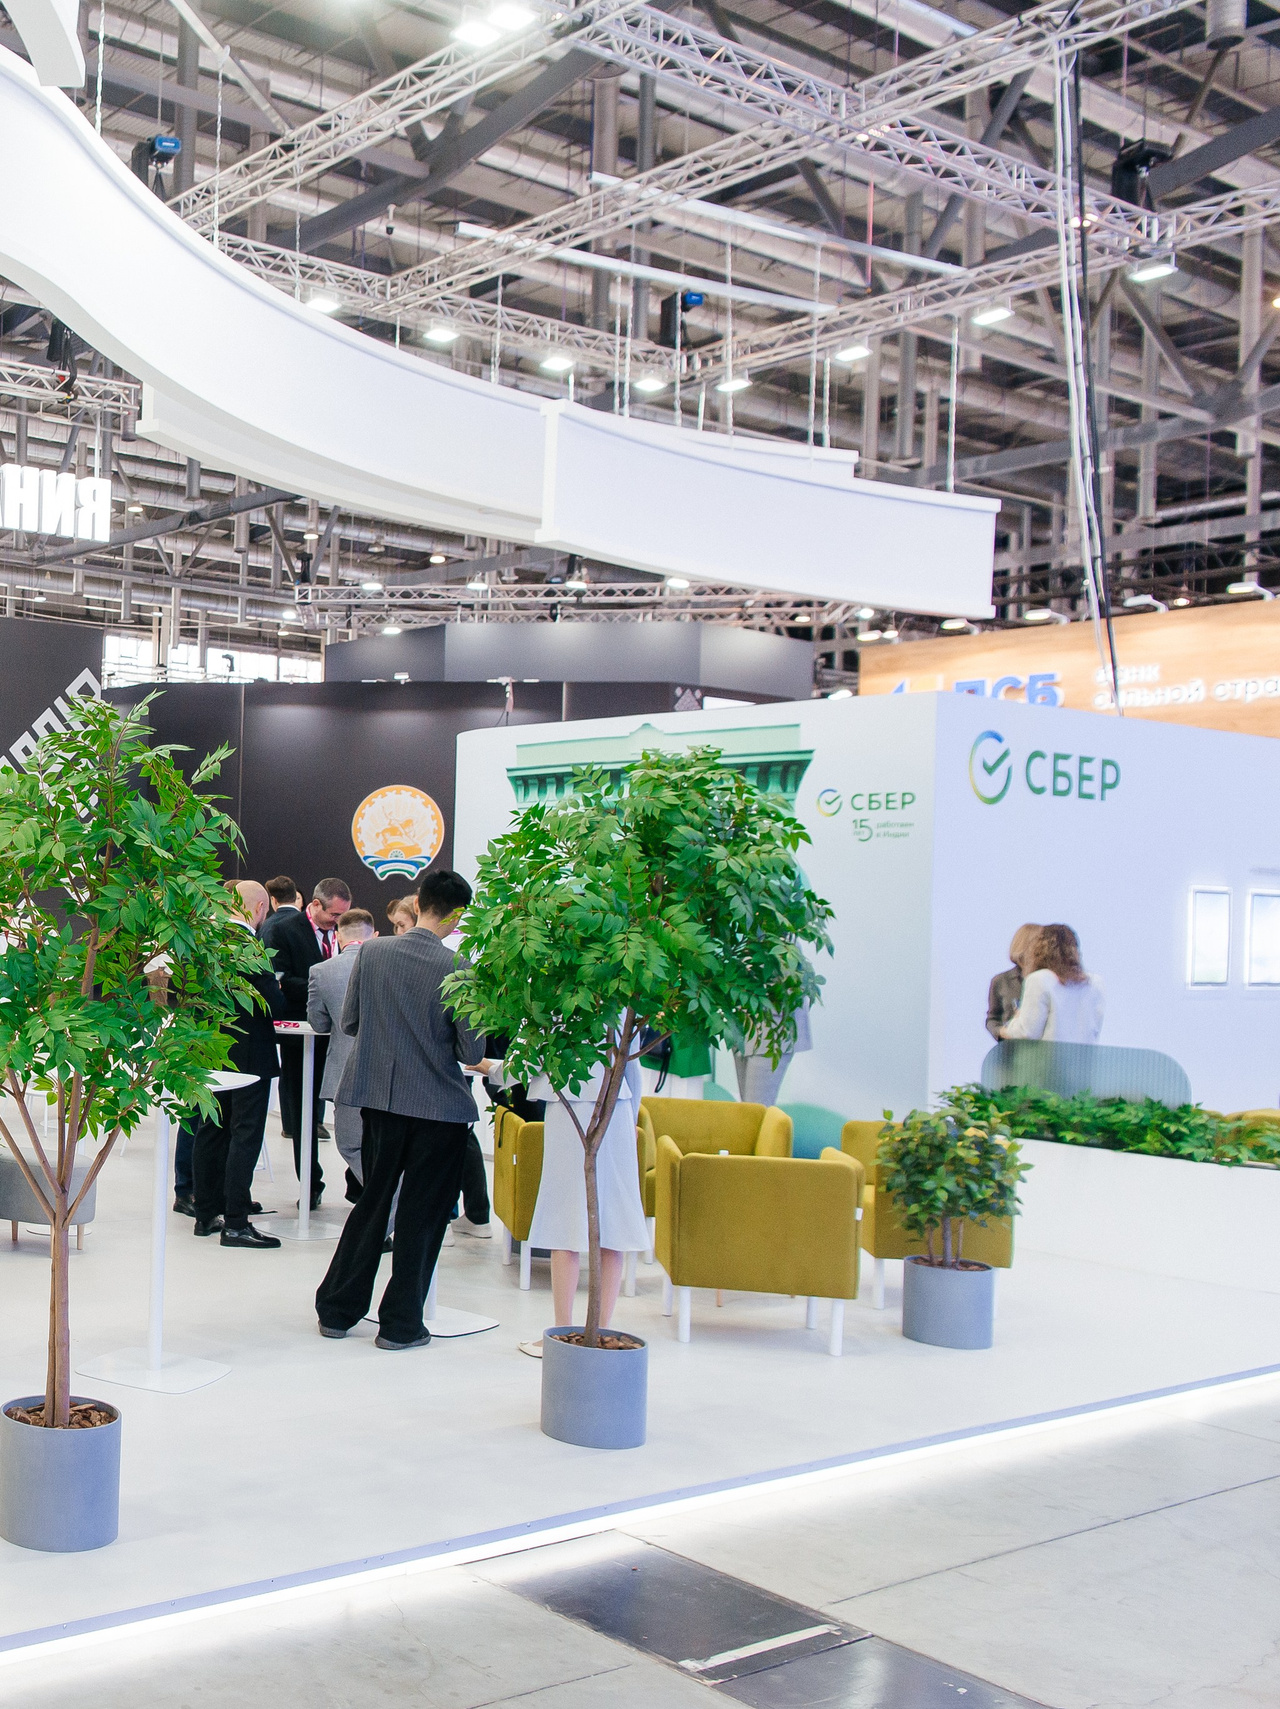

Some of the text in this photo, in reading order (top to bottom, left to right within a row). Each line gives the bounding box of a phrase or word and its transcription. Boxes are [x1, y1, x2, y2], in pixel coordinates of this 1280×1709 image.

[1025, 750, 1121, 801] СБЕР
[850, 792, 916, 811] СБЕР
[852, 818, 873, 842] 15
